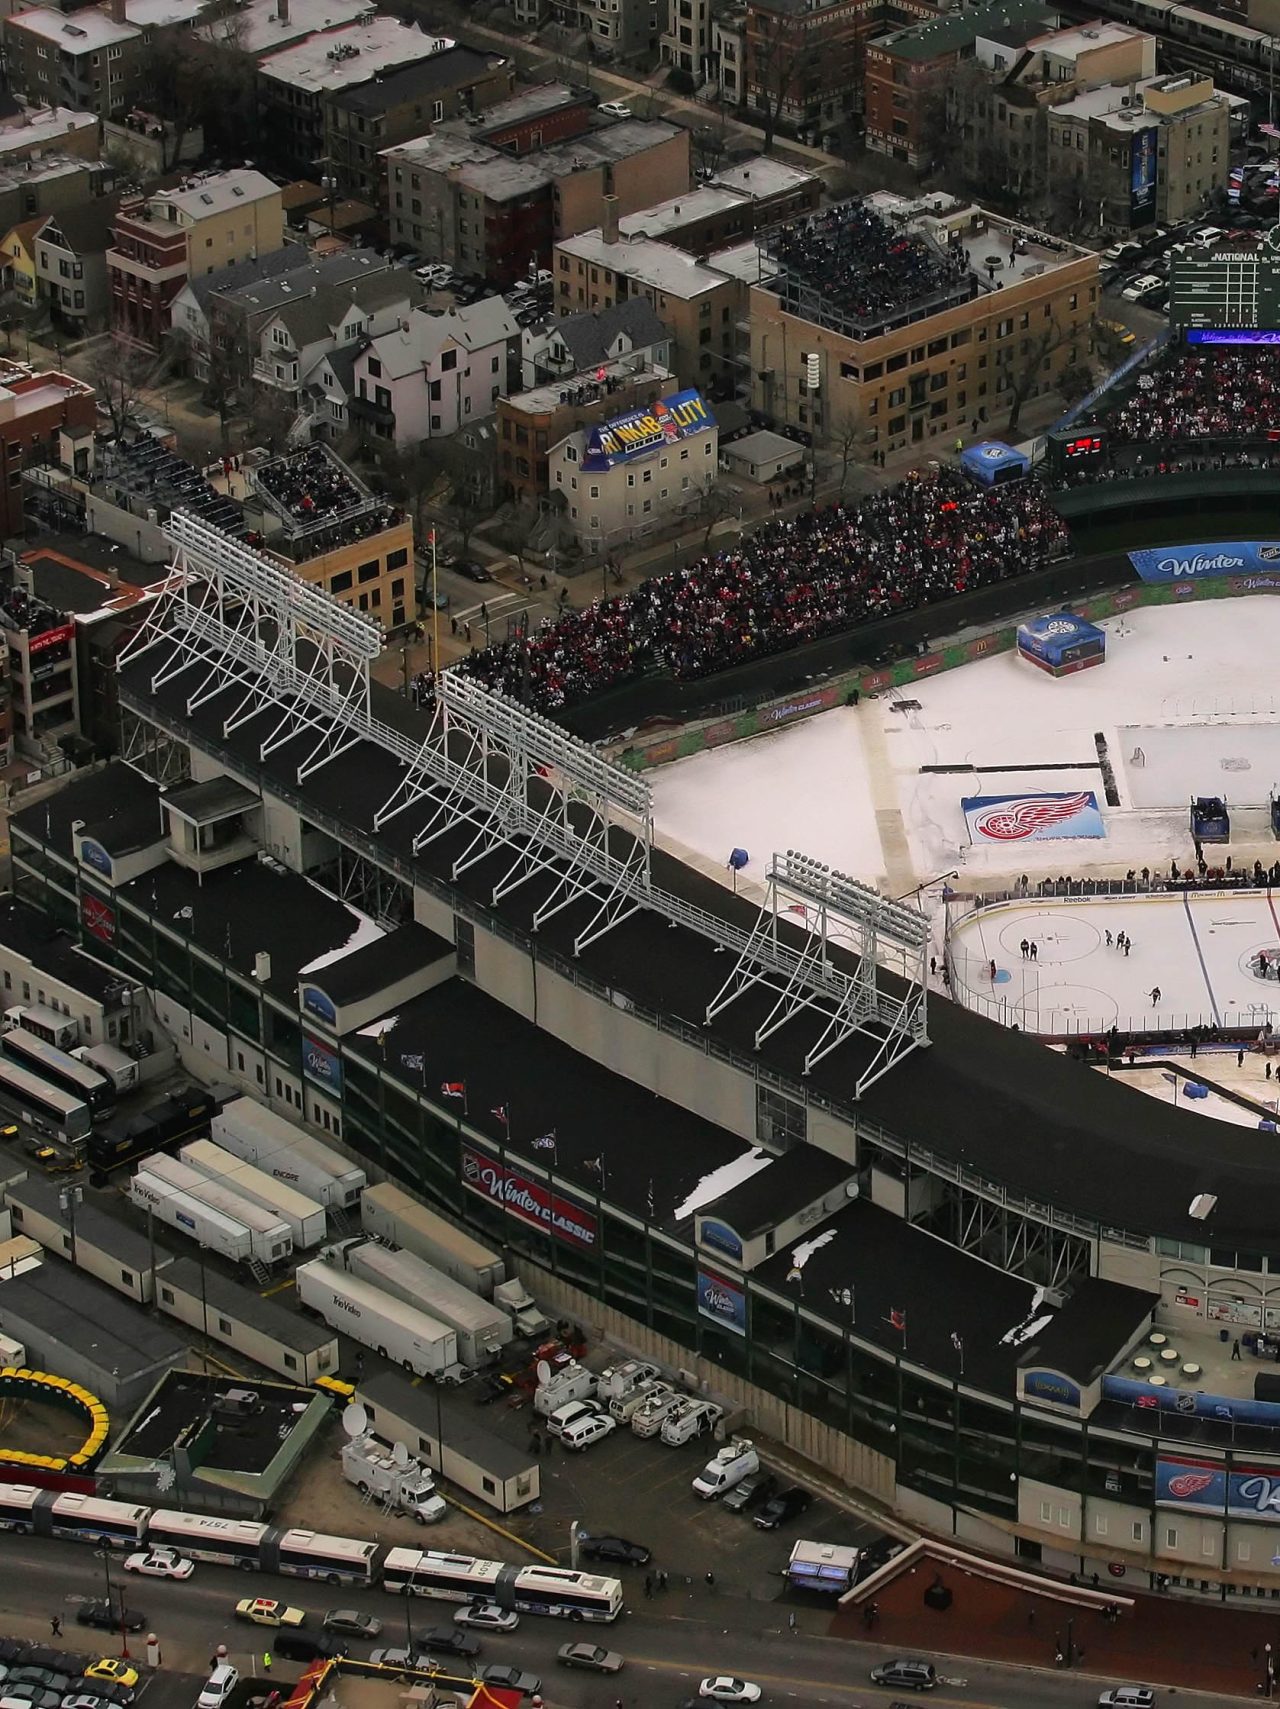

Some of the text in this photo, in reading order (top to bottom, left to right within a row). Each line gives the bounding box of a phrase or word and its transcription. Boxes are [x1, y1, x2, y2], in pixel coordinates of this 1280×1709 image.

[1214, 252, 1260, 262] NATIONAL
[1157, 554, 1245, 577] Winter
[1063, 896, 1091, 904] Reebok
[273, 1169, 300, 1182] ENCORE
[481, 1168, 595, 1244] Winter CLASSIC
[199, 1519, 229, 1530] 7574
